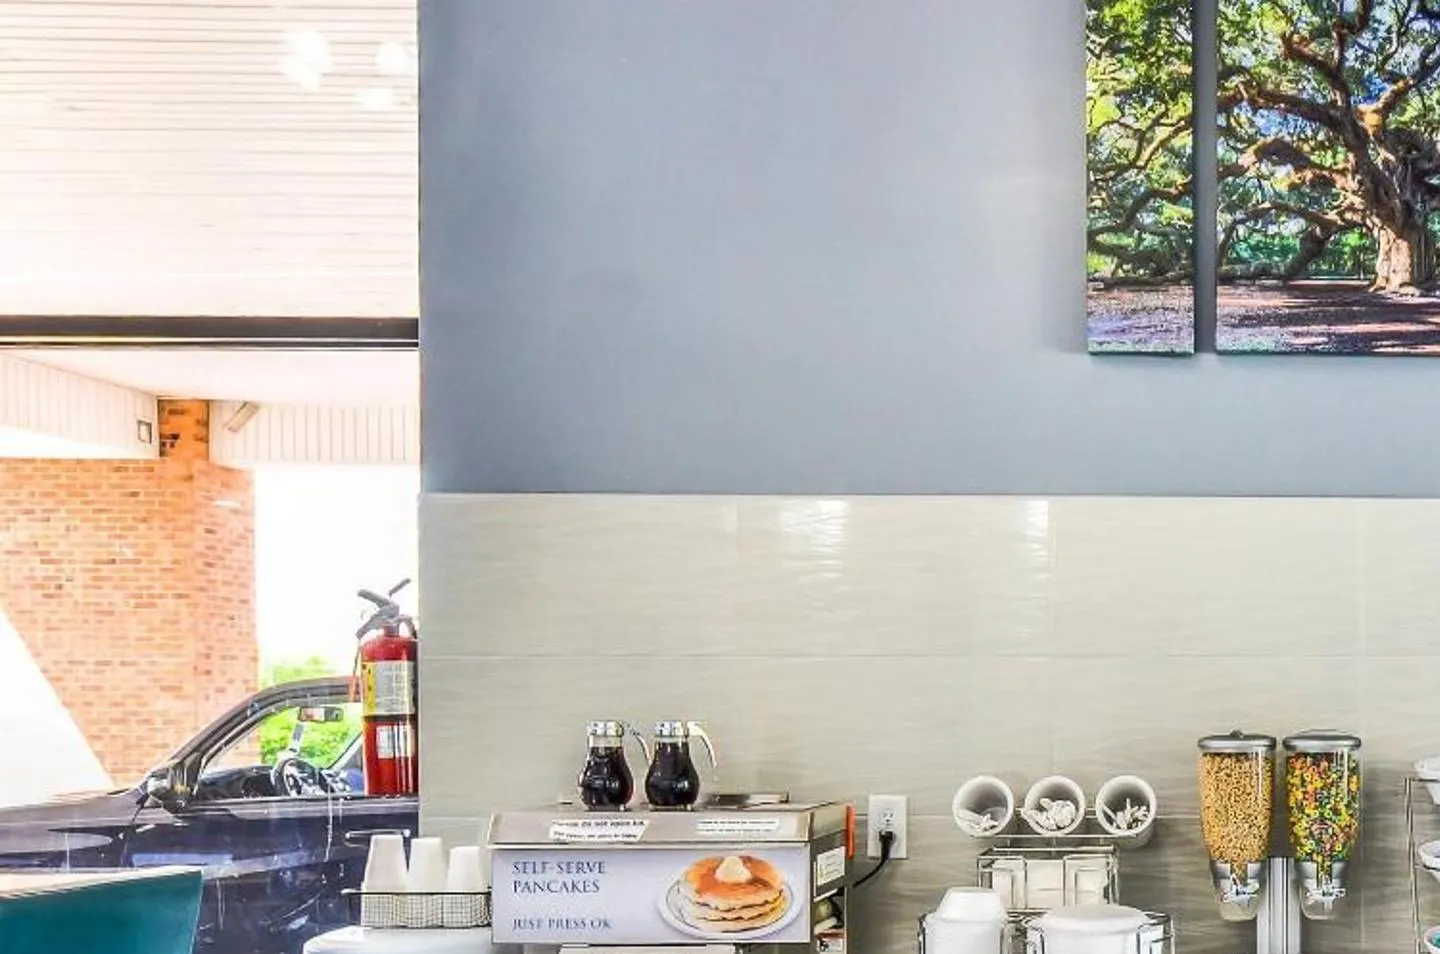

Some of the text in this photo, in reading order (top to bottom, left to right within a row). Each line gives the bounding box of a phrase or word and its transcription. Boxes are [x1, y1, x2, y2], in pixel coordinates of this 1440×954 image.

[512, 860, 607, 875] SELF-SERVE
[513, 880, 601, 894] PANCAKES
[512, 918, 613, 930] JUST PRESS OK
